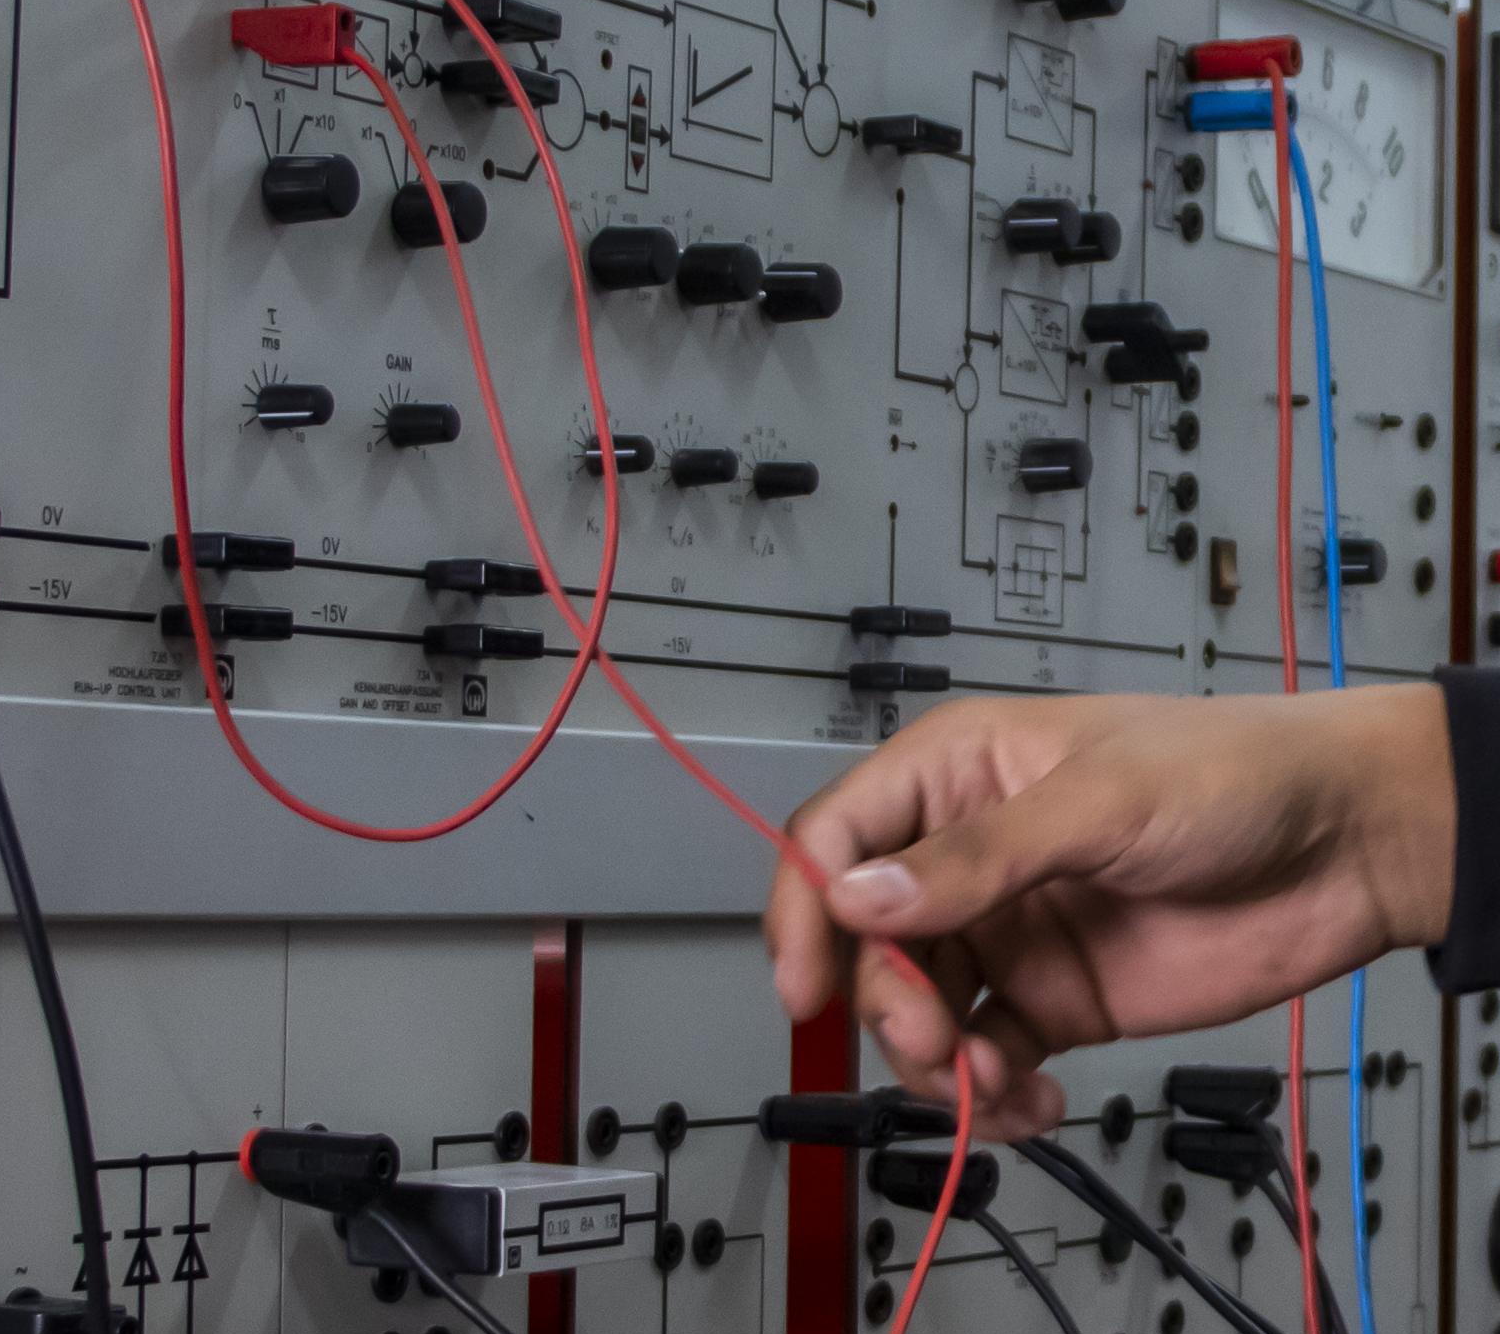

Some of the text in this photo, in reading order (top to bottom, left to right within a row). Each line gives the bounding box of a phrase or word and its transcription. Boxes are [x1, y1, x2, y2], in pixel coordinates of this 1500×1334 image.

[233, 93, 243, 110] 0
[273, 86, 287, 104] x1
[314, 114, 336, 132] x10
[361, 124, 374, 142] x1
[439, 144, 467, 163] x100
[385, 353, 413, 373] GAIN
[41, 504, 65, 528] 0V
[321, 536, 341, 557] 0V
[28, 579, 73, 601] -15V
[670, 575, 687, 595] 0V
[310, 604, 349, 625] -15V
[661, 637, 693, 656] -15V
